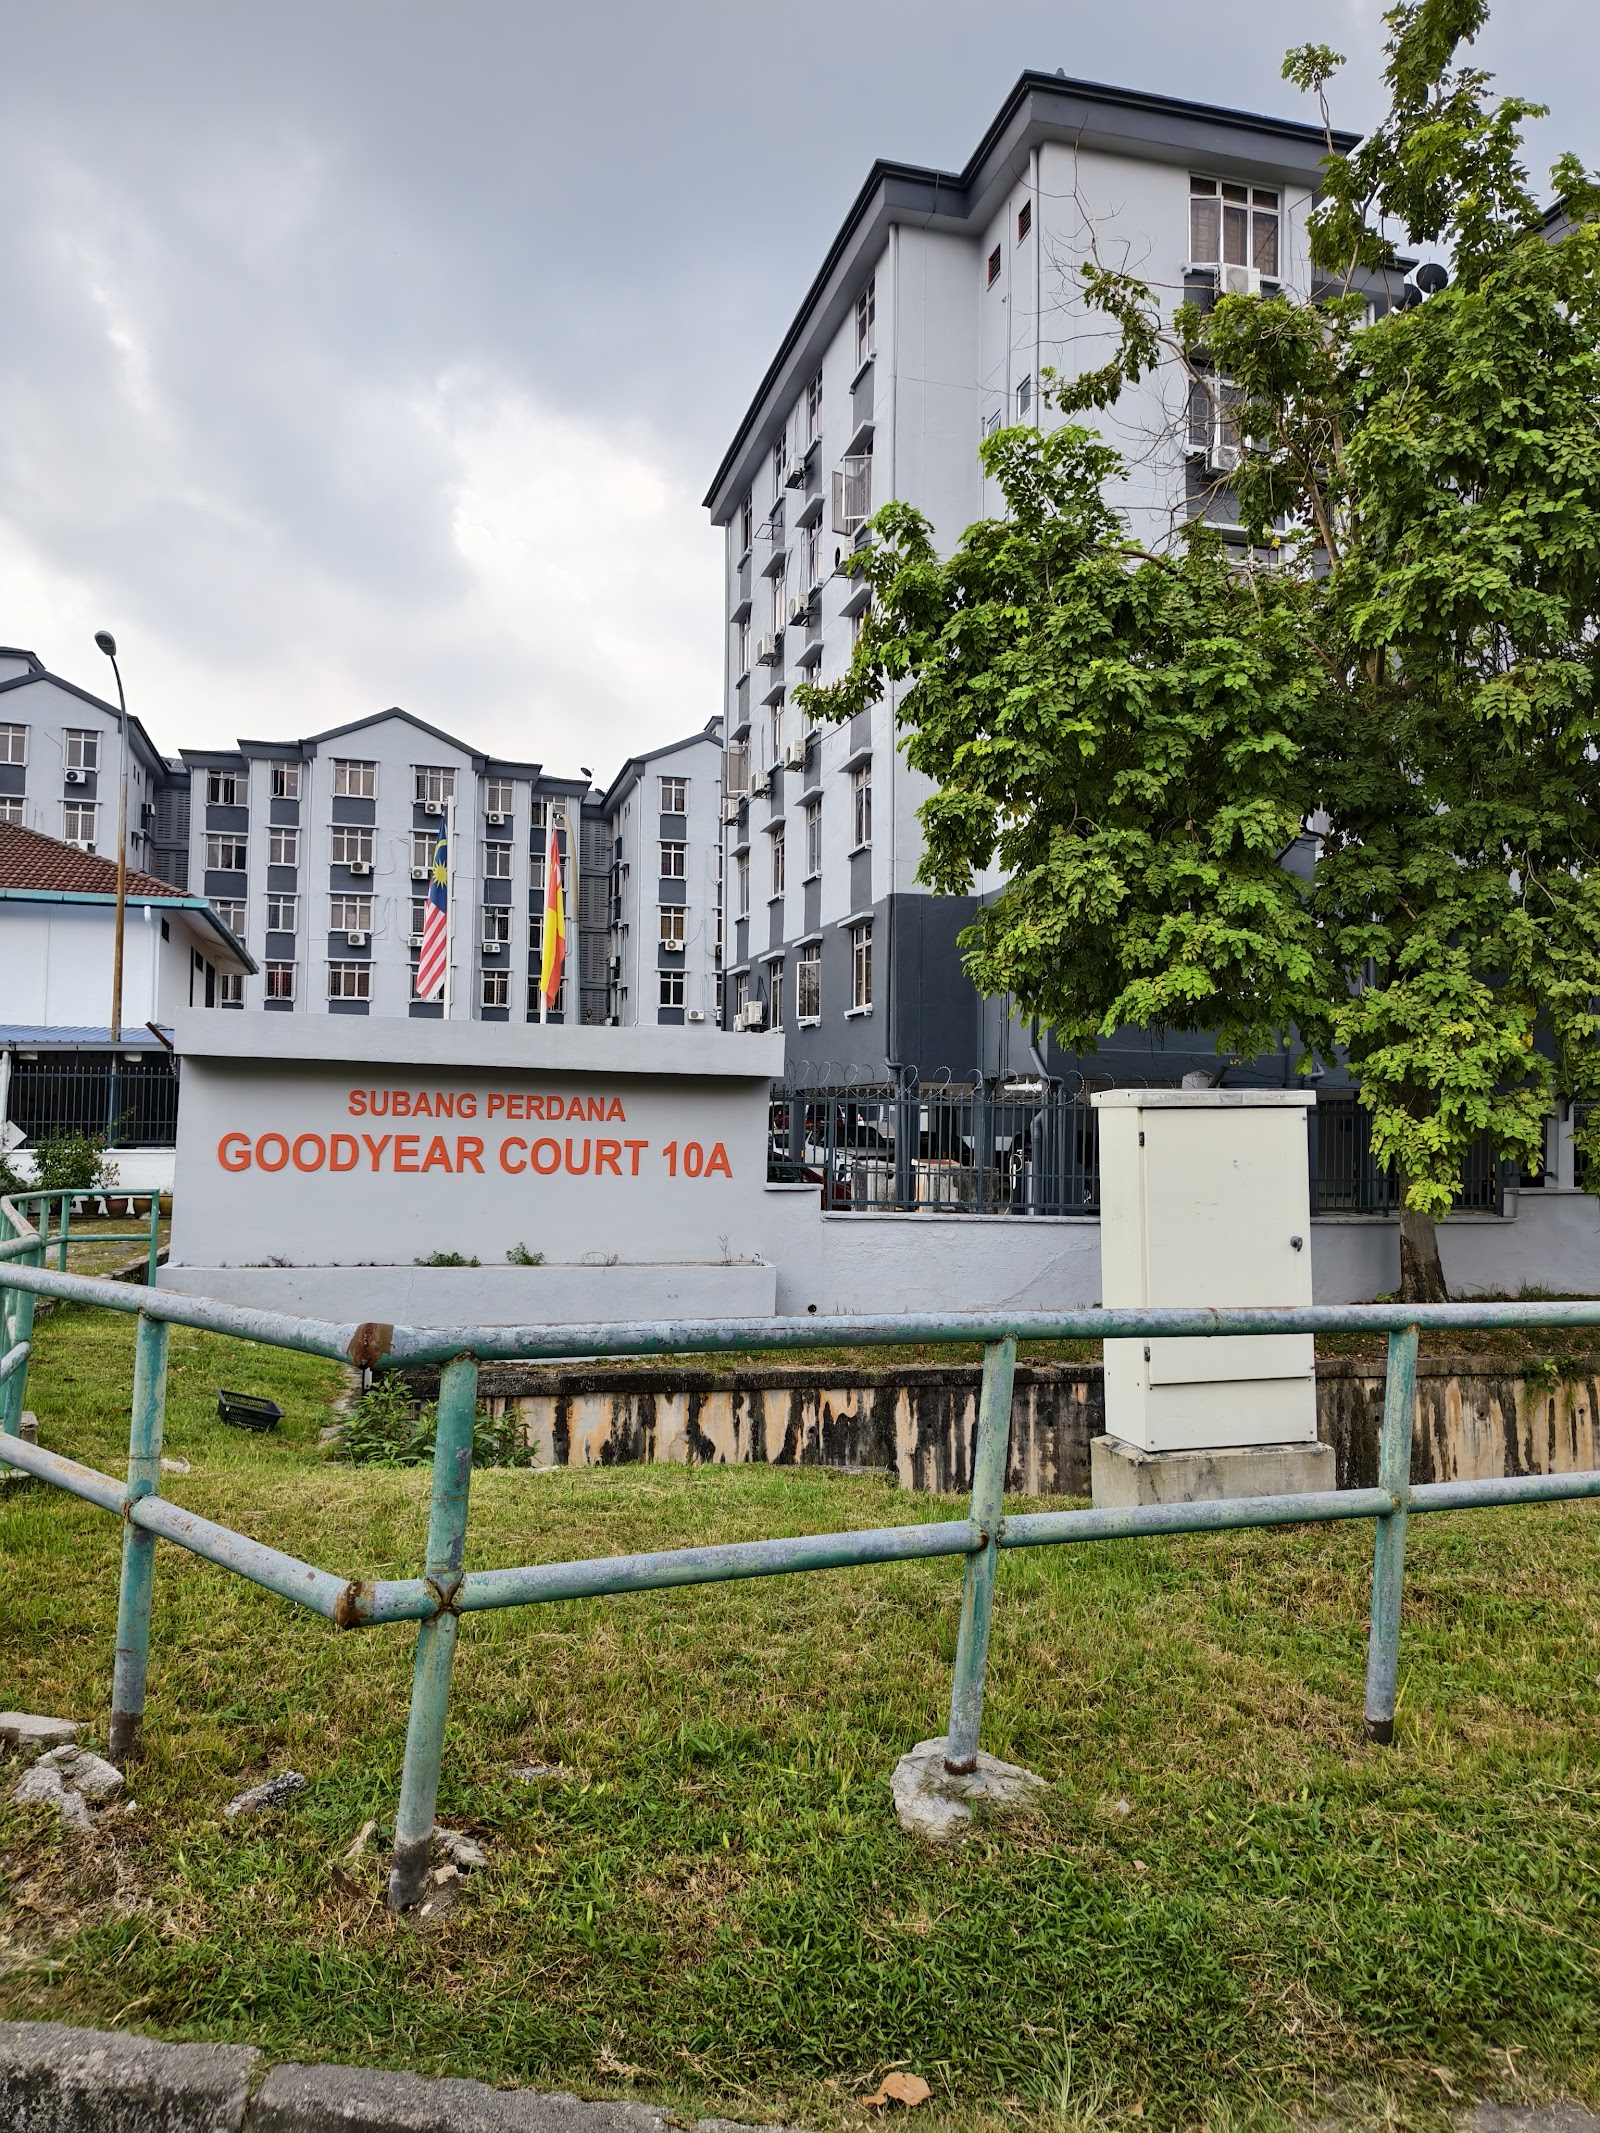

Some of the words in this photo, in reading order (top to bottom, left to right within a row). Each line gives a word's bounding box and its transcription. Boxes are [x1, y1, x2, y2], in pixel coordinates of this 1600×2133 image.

[348, 1089, 478, 1119] SUBANG
[486, 1093, 627, 1123] PERDANA
[217, 1132, 486, 1174] GOODYEAR
[499, 1136, 650, 1177] COURT
[661, 1141, 734, 1179] 10A
